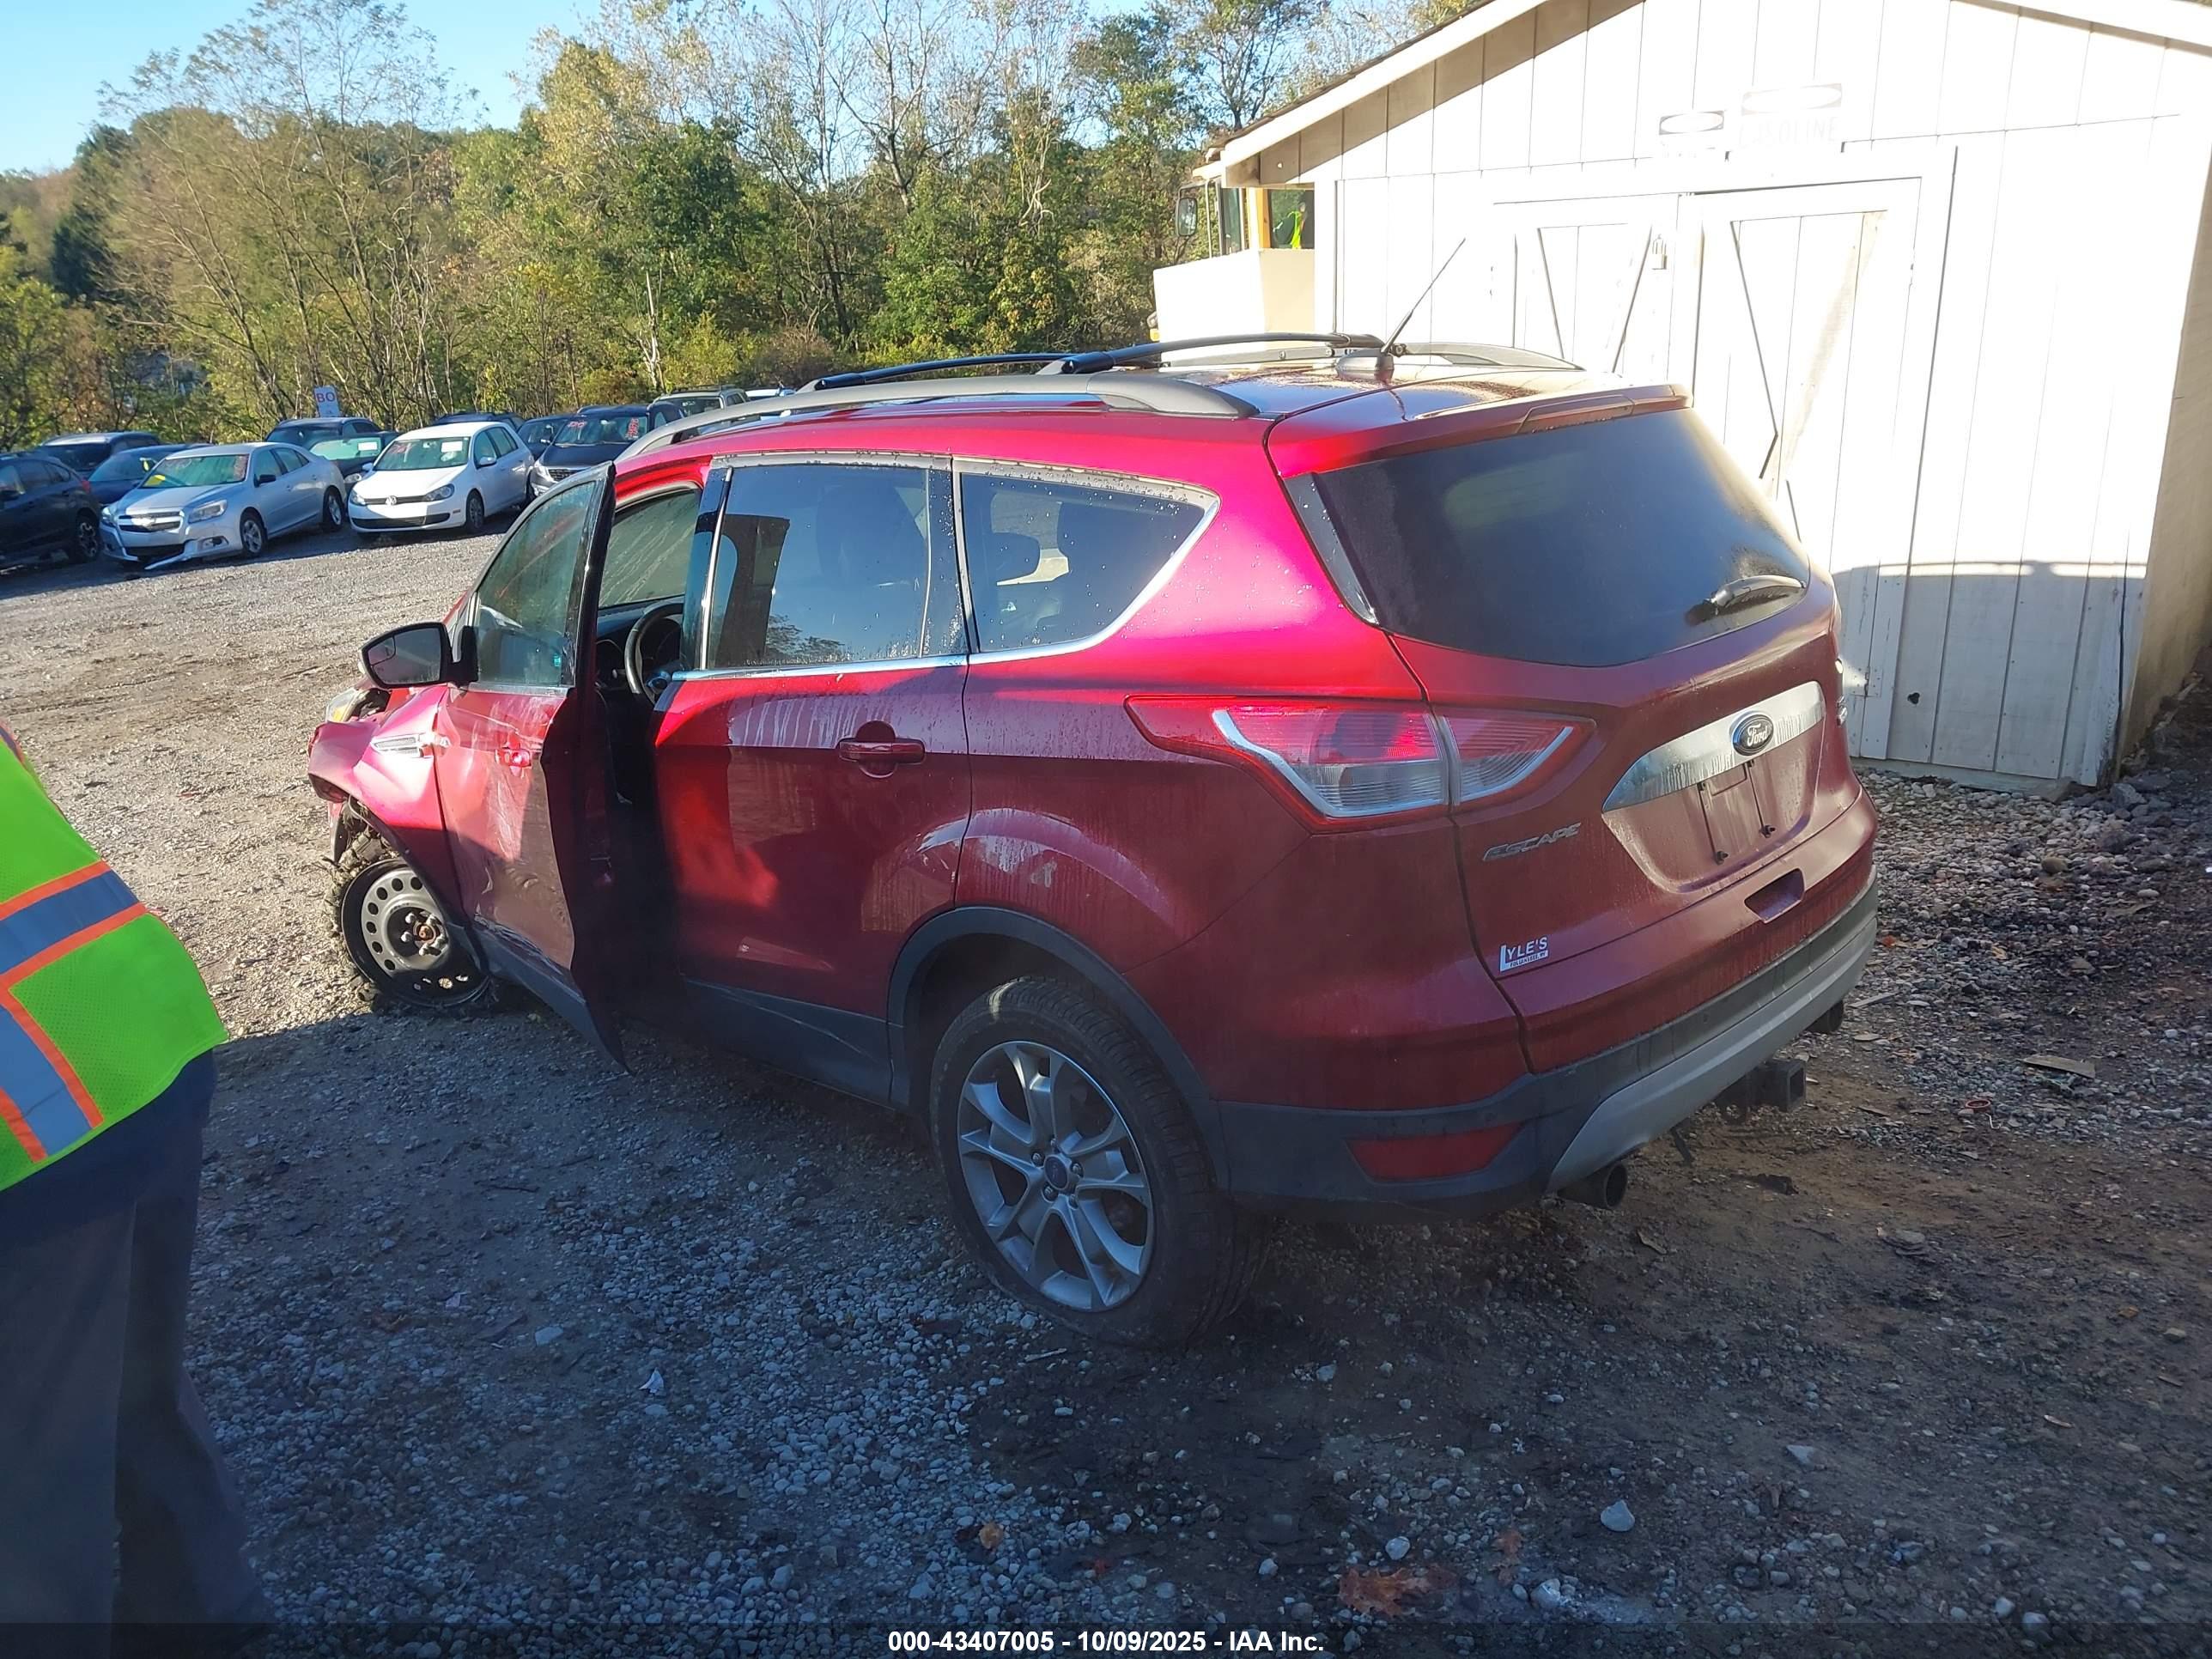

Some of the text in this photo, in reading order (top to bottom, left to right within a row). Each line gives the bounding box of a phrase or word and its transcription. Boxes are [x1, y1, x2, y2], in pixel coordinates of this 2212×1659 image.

[1747, 723, 1769, 747] Ford
[1482, 822, 1581, 860] ESCAPE
[1500, 937, 1548, 971] LYLE'S
